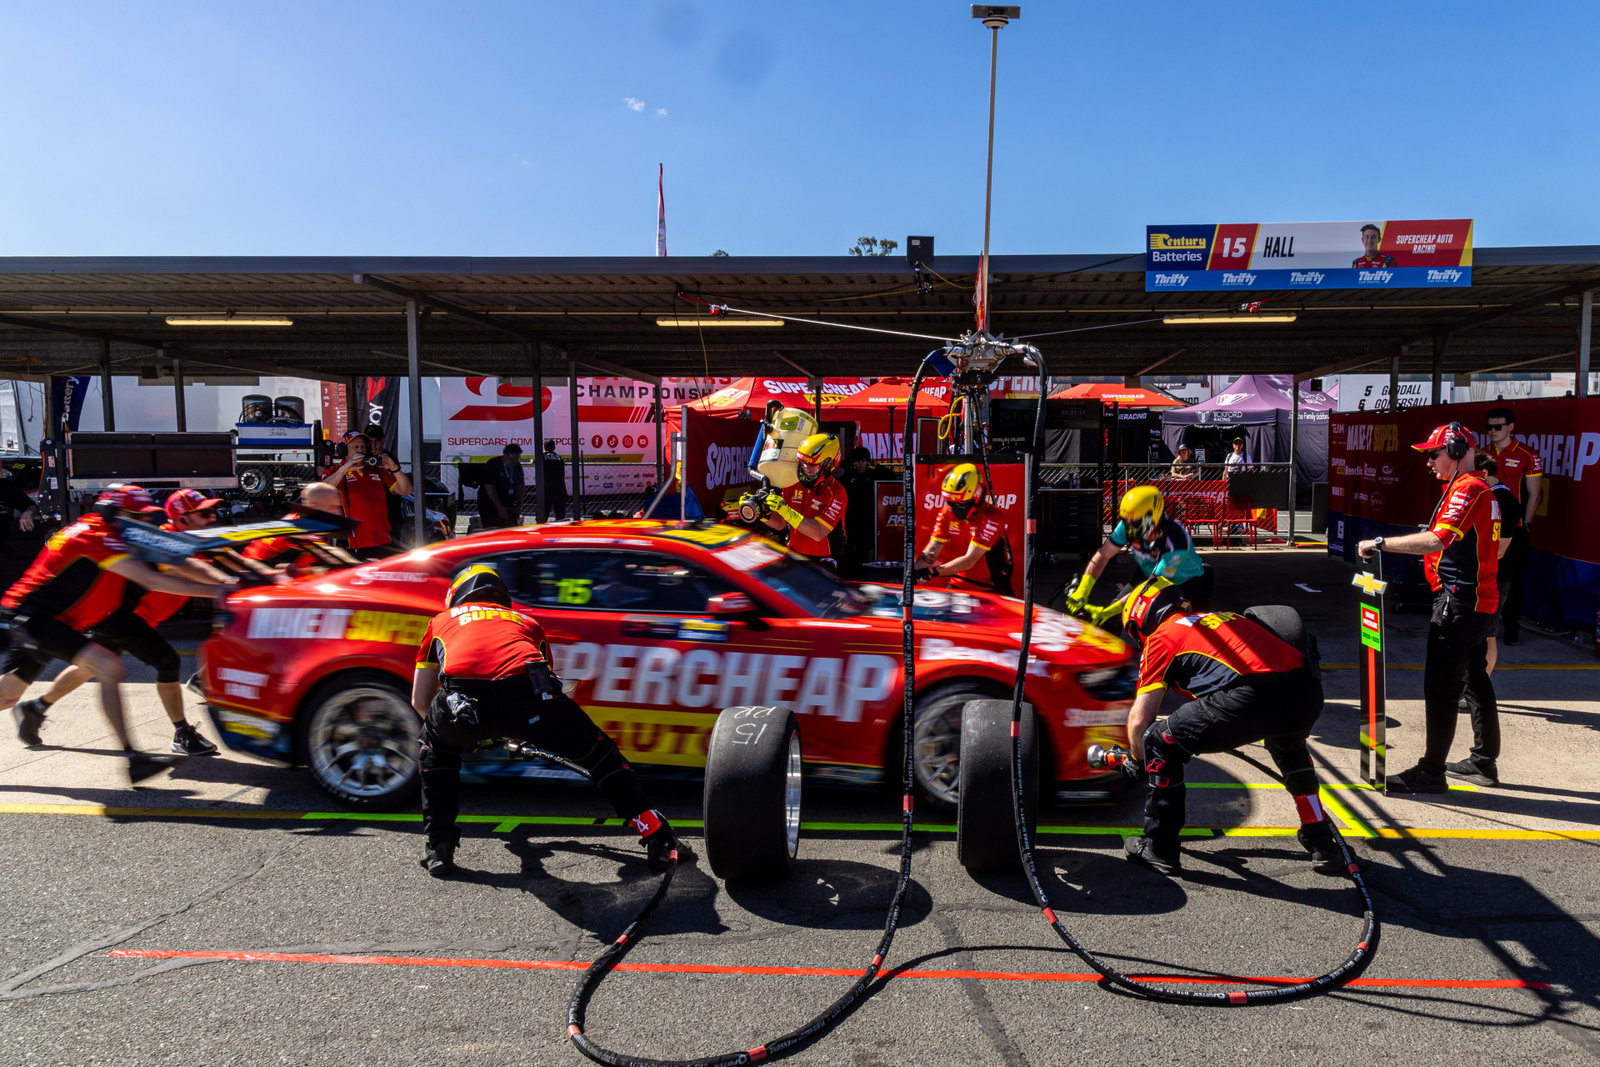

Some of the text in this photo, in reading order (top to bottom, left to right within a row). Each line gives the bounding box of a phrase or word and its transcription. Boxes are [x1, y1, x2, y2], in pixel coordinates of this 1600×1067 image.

[1150, 233, 1206, 249] Century
[1396, 233, 1453, 244] SUPERCHEAP AUTO
[1222, 237, 1247, 258] 15
[1263, 236, 1294, 258] HALL
[1412, 244, 1436, 254] RACING
[1152, 251, 1202, 262] Batteries
[1155, 273, 1189, 287] Thrifty
[1222, 272, 1257, 286] Thrifty
[1290, 271, 1325, 285] Thrifty
[1358, 270, 1393, 284] Thrifty
[1427, 269, 1462, 283] Thrifty
[1364, 385, 1373, 397] 5
[794, 489, 803, 498] 15
[555, 578, 593, 604] 15
[732, 723, 767, 745] 15
